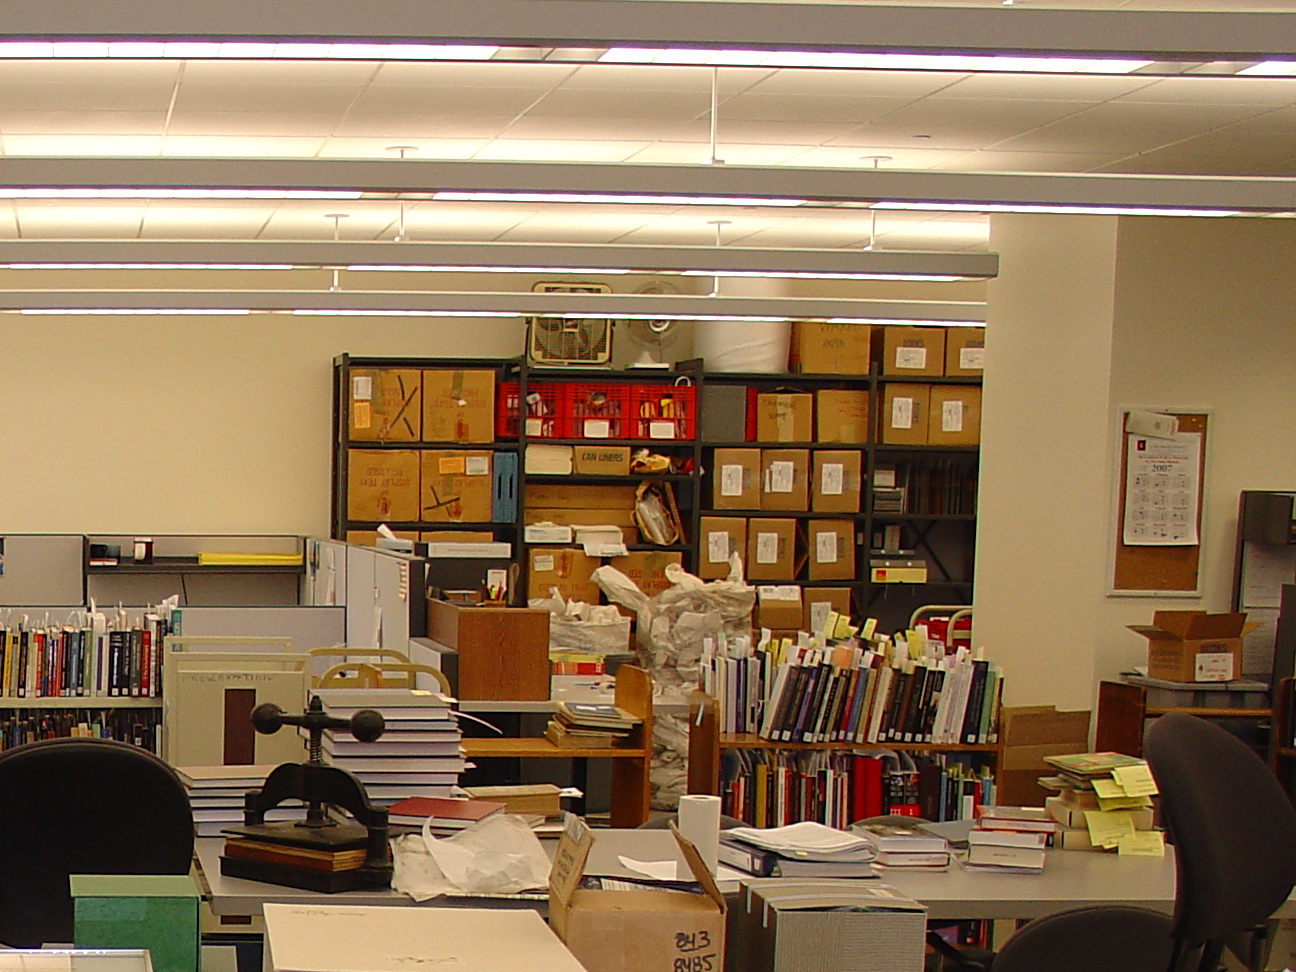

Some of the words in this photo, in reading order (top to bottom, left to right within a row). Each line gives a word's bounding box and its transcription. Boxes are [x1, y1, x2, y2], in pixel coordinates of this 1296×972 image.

[581, 452, 597, 462] CAN
[597, 451, 624, 463] LINERS
[674, 930, 711, 950] 843
